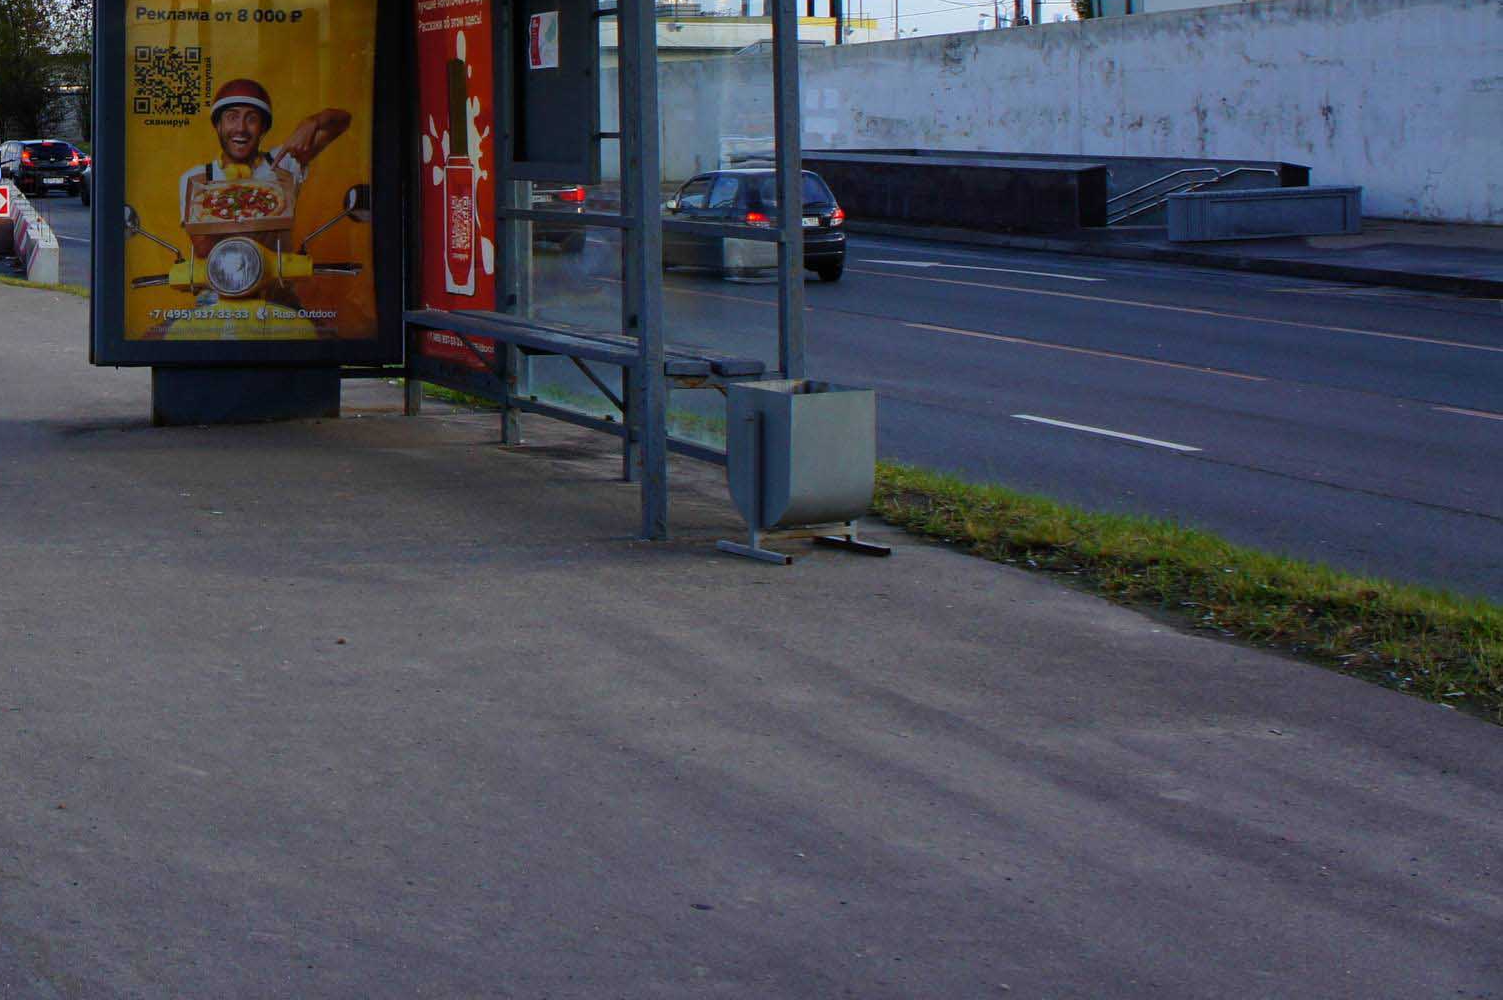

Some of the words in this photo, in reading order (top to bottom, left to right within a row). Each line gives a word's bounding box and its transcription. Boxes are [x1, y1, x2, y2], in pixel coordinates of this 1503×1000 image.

[135, 6, 211, 22] Реклама
[214, 11, 232, 22] от
[236, 9, 249, 22] 8
[253, 9, 287, 23] 000
[145, 118, 190, 128] сканируй
[148, 309, 162, 319] +7
[163, 308, 192, 321] (495)
[298, 308, 338, 319] Outdoor
